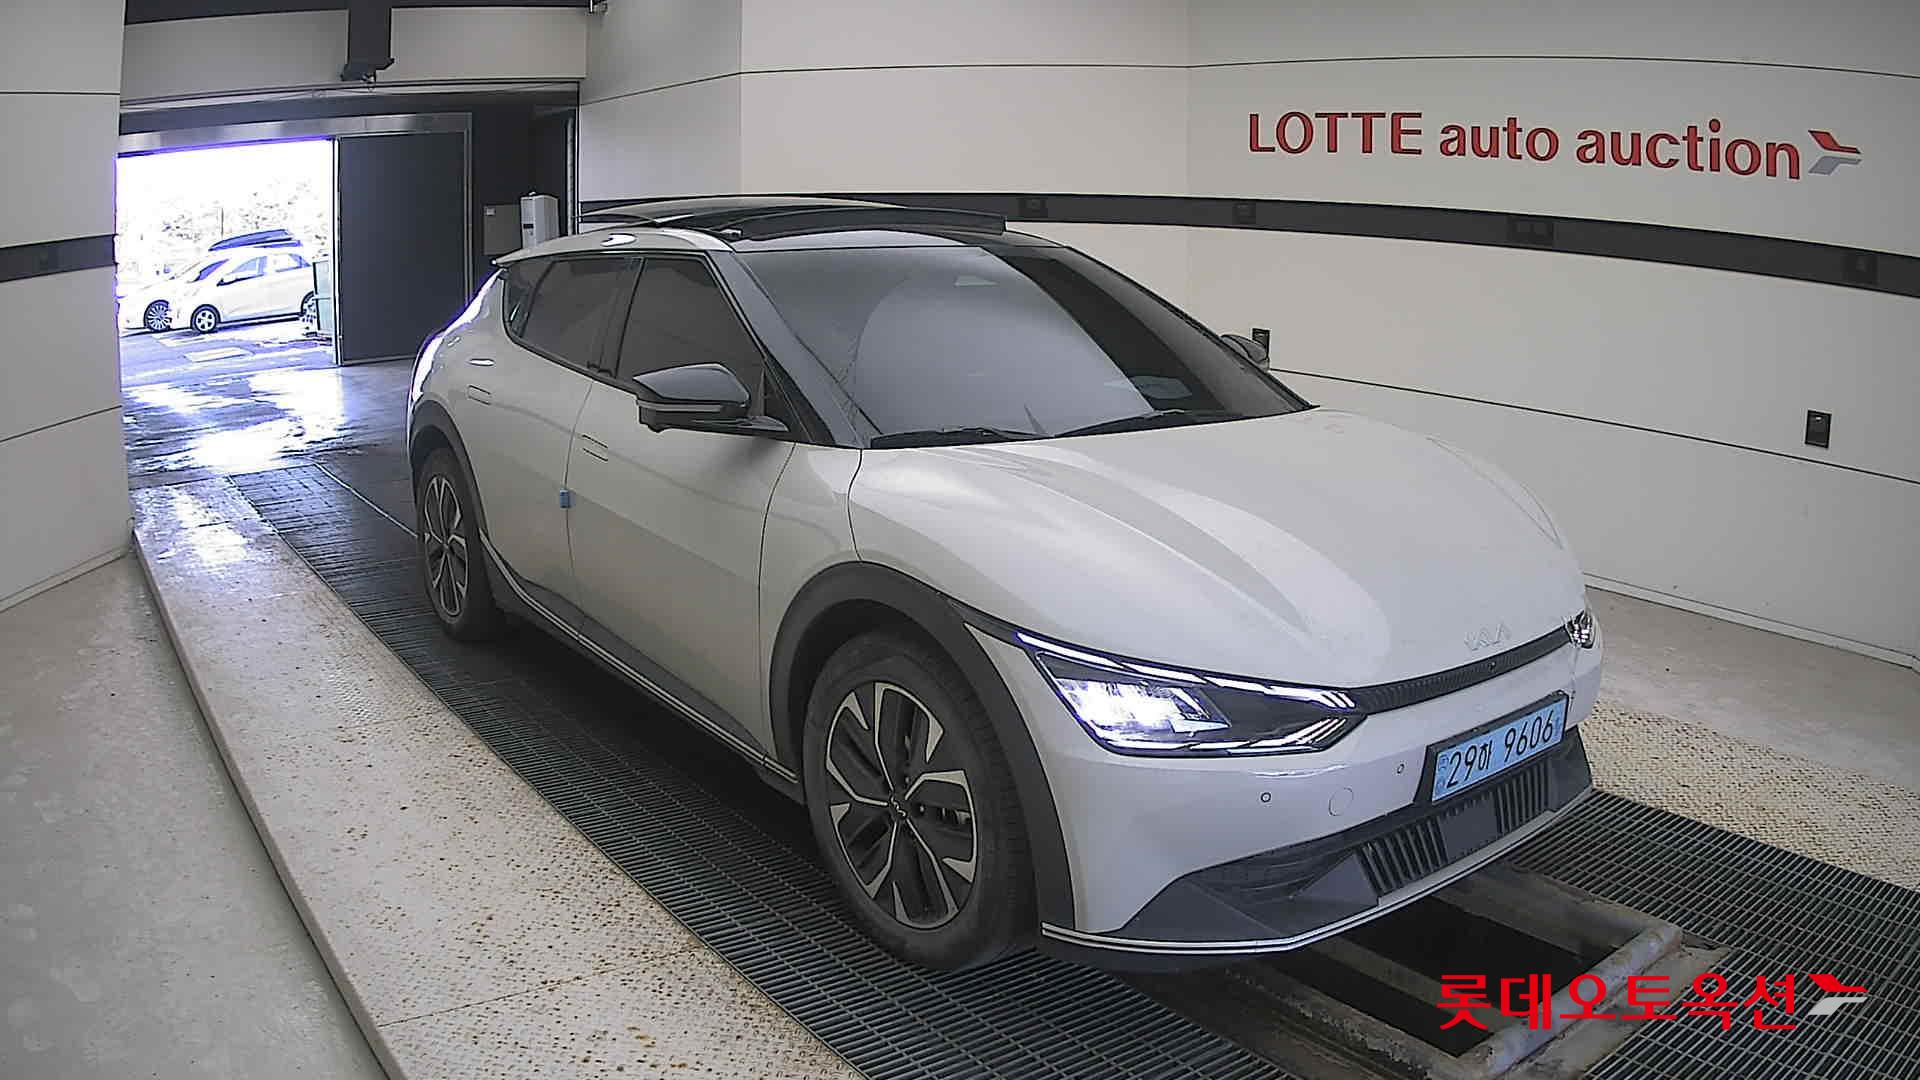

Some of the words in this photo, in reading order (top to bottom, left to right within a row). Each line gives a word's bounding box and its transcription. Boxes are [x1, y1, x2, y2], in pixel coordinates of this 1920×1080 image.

[1248, 111, 1424, 155] LOTTE
[1439, 116, 1560, 161] auto
[1575, 119, 1800, 180] auction
[1504, 711, 1554, 763] 9606
